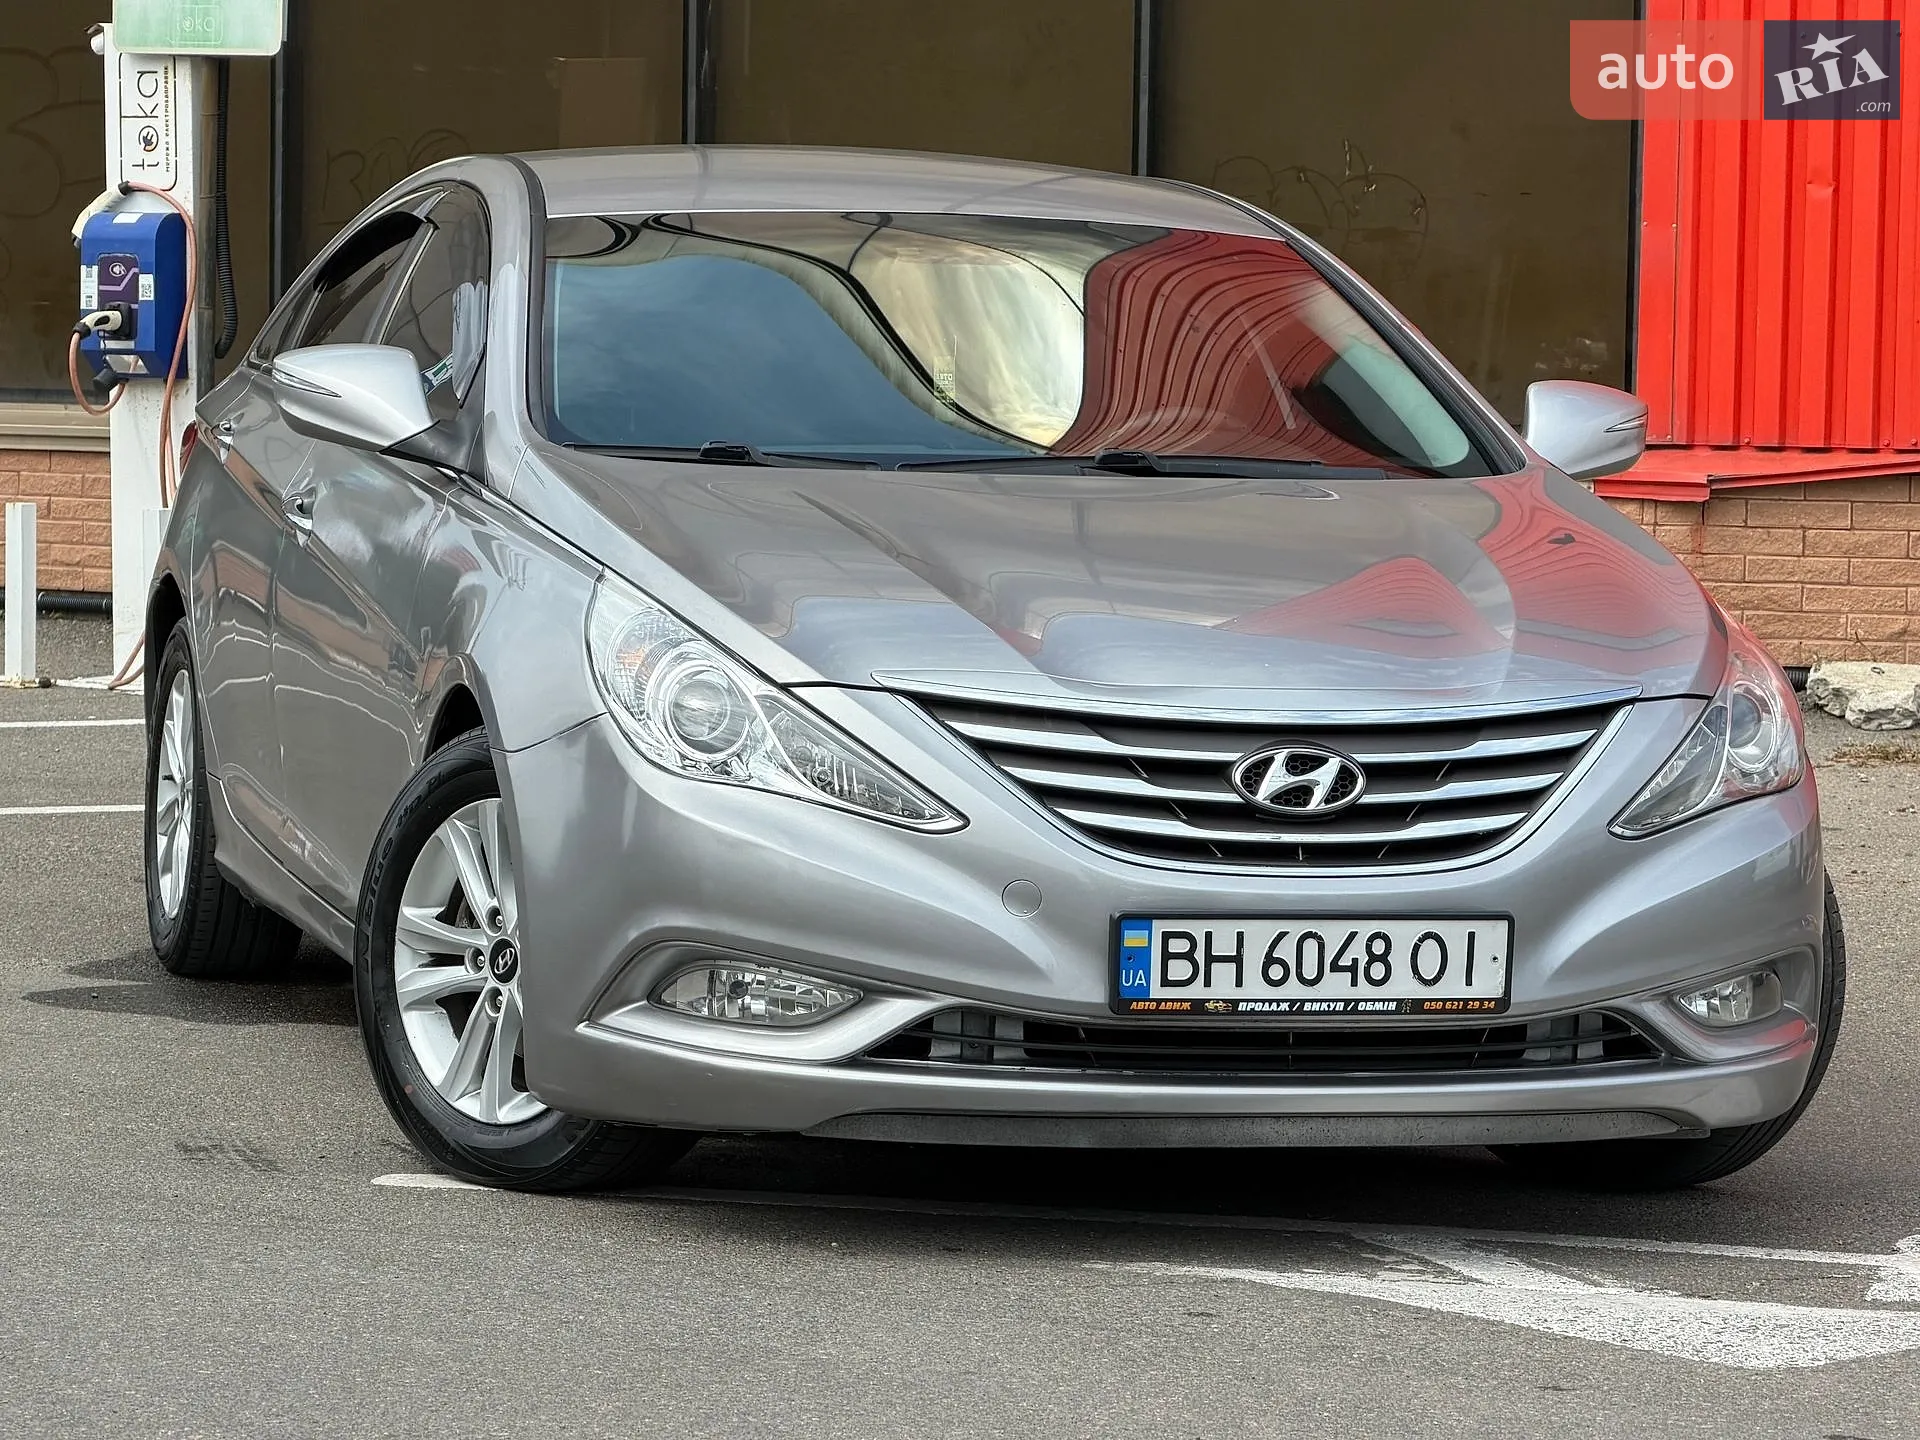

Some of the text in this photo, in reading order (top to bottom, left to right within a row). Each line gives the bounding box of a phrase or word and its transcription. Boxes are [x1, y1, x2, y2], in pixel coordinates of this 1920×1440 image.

[1261, 930, 1393, 988] 6048
[1121, 969, 1147, 987] UA
[1129, 1001, 1157, 1010] АВТО
[1158, 1001, 1192, 1010] ДВИЖ
[1237, 1001, 1290, 1011] ПРОДАЖ
[1303, 1001, 1345, 1011] ВИКУП
[1357, 1001, 1398, 1011] ОБМІН
[1423, 1001, 1443, 1010] 050
[1445, 1001, 1463, 1010] 621
[1467, 1001, 1480, 1010] 29
[1481, 1001, 1496, 1010] 34
